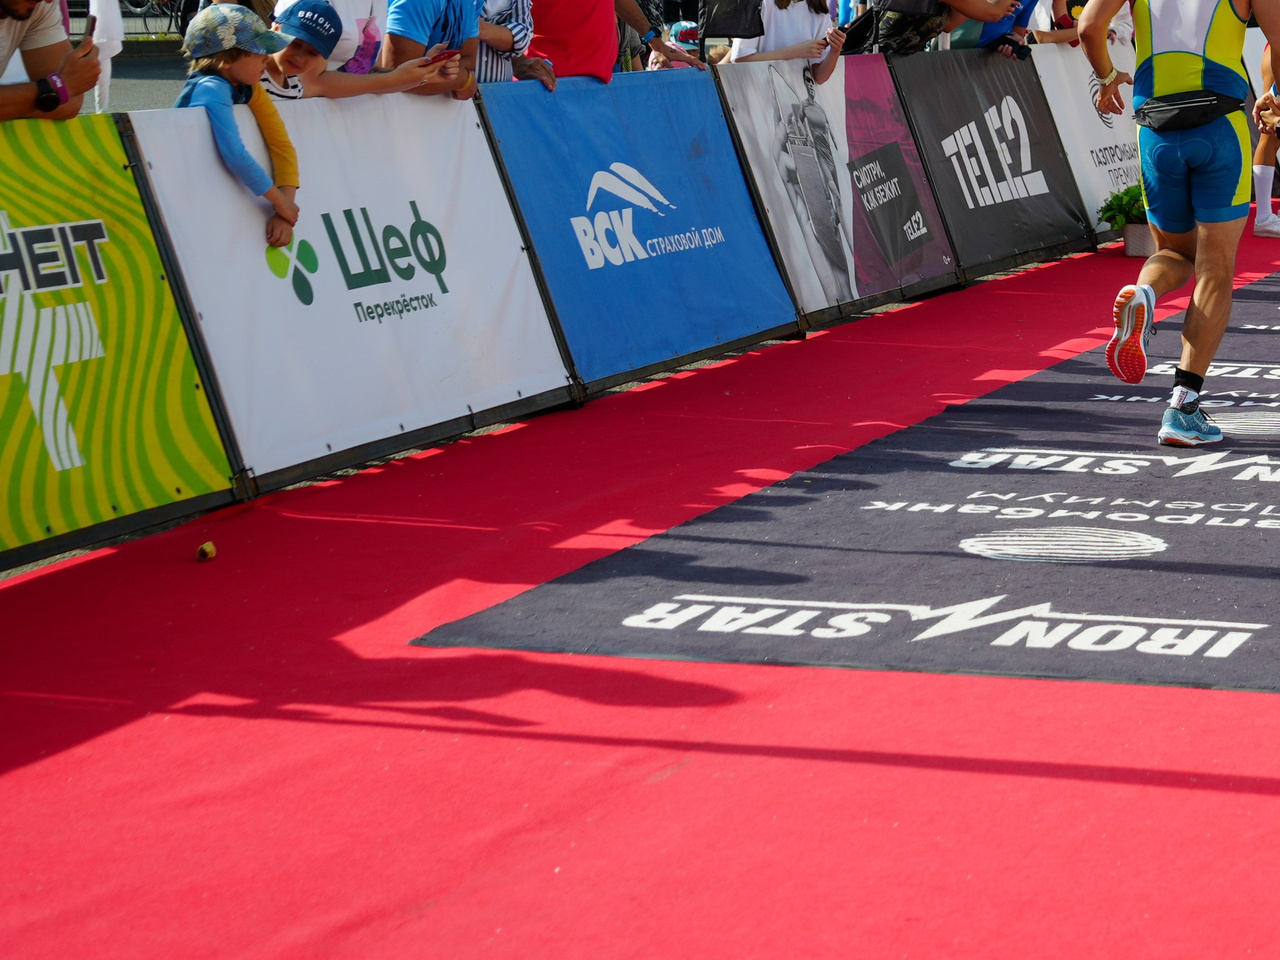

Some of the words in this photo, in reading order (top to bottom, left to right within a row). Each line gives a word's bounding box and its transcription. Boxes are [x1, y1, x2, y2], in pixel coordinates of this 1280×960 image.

[297, 10, 335, 35] BRIGHT
[941, 95, 1049, 210] TELE2
[570, 207, 649, 270] ВСК
[646, 227, 703, 257] СТРАХОВОЙ
[701, 226, 725, 249] ДОМ
[903, 210, 928, 242] TELE2
[321, 200, 449, 294] Шеф
[353, 293, 438, 324] Перекрёсток
[948, 450, 1139, 476] STAR
[622, 604, 893, 640] STAR
[990, 620, 1254, 658] IRON
